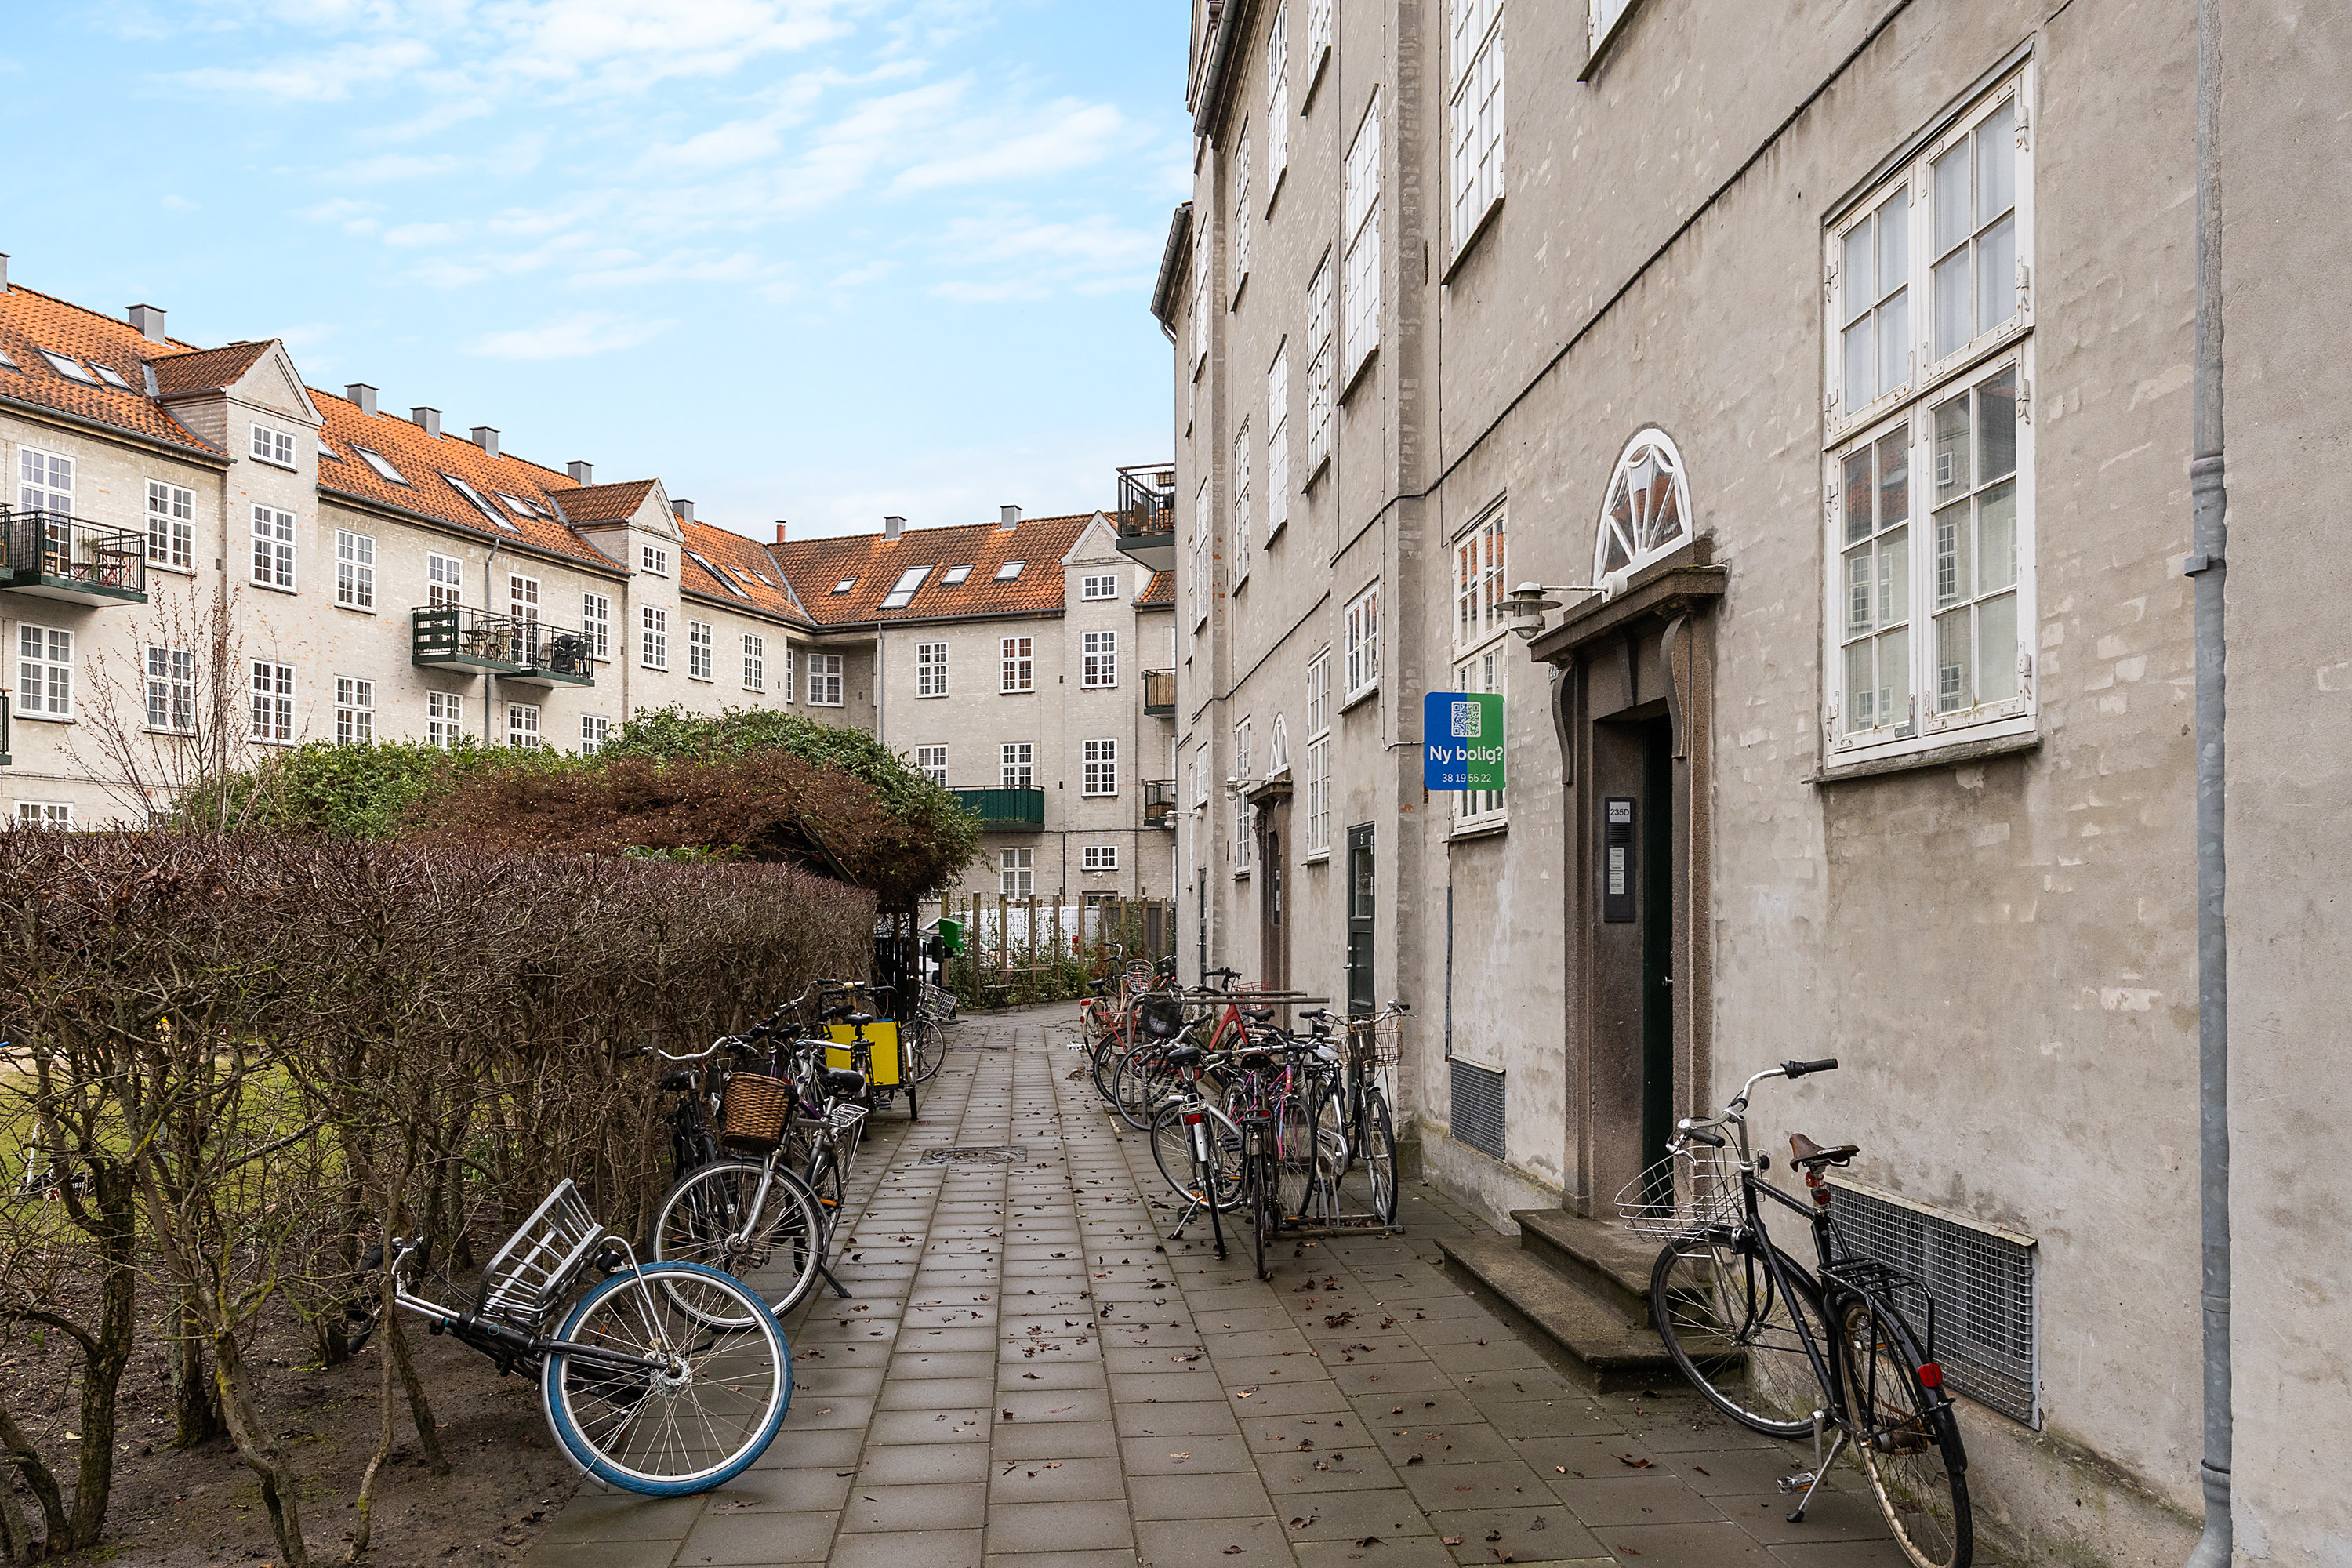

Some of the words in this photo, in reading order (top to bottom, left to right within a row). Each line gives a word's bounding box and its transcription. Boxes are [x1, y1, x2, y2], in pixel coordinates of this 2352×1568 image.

[1429, 746, 1453, 765] Ny
[1456, 746, 1504, 765] bolig?
[1442, 773, 1454, 782] 38
[1455, 773, 1467, 782] 19
[1468, 773, 1479, 782] 55
[1480, 773, 1492, 782] 22
